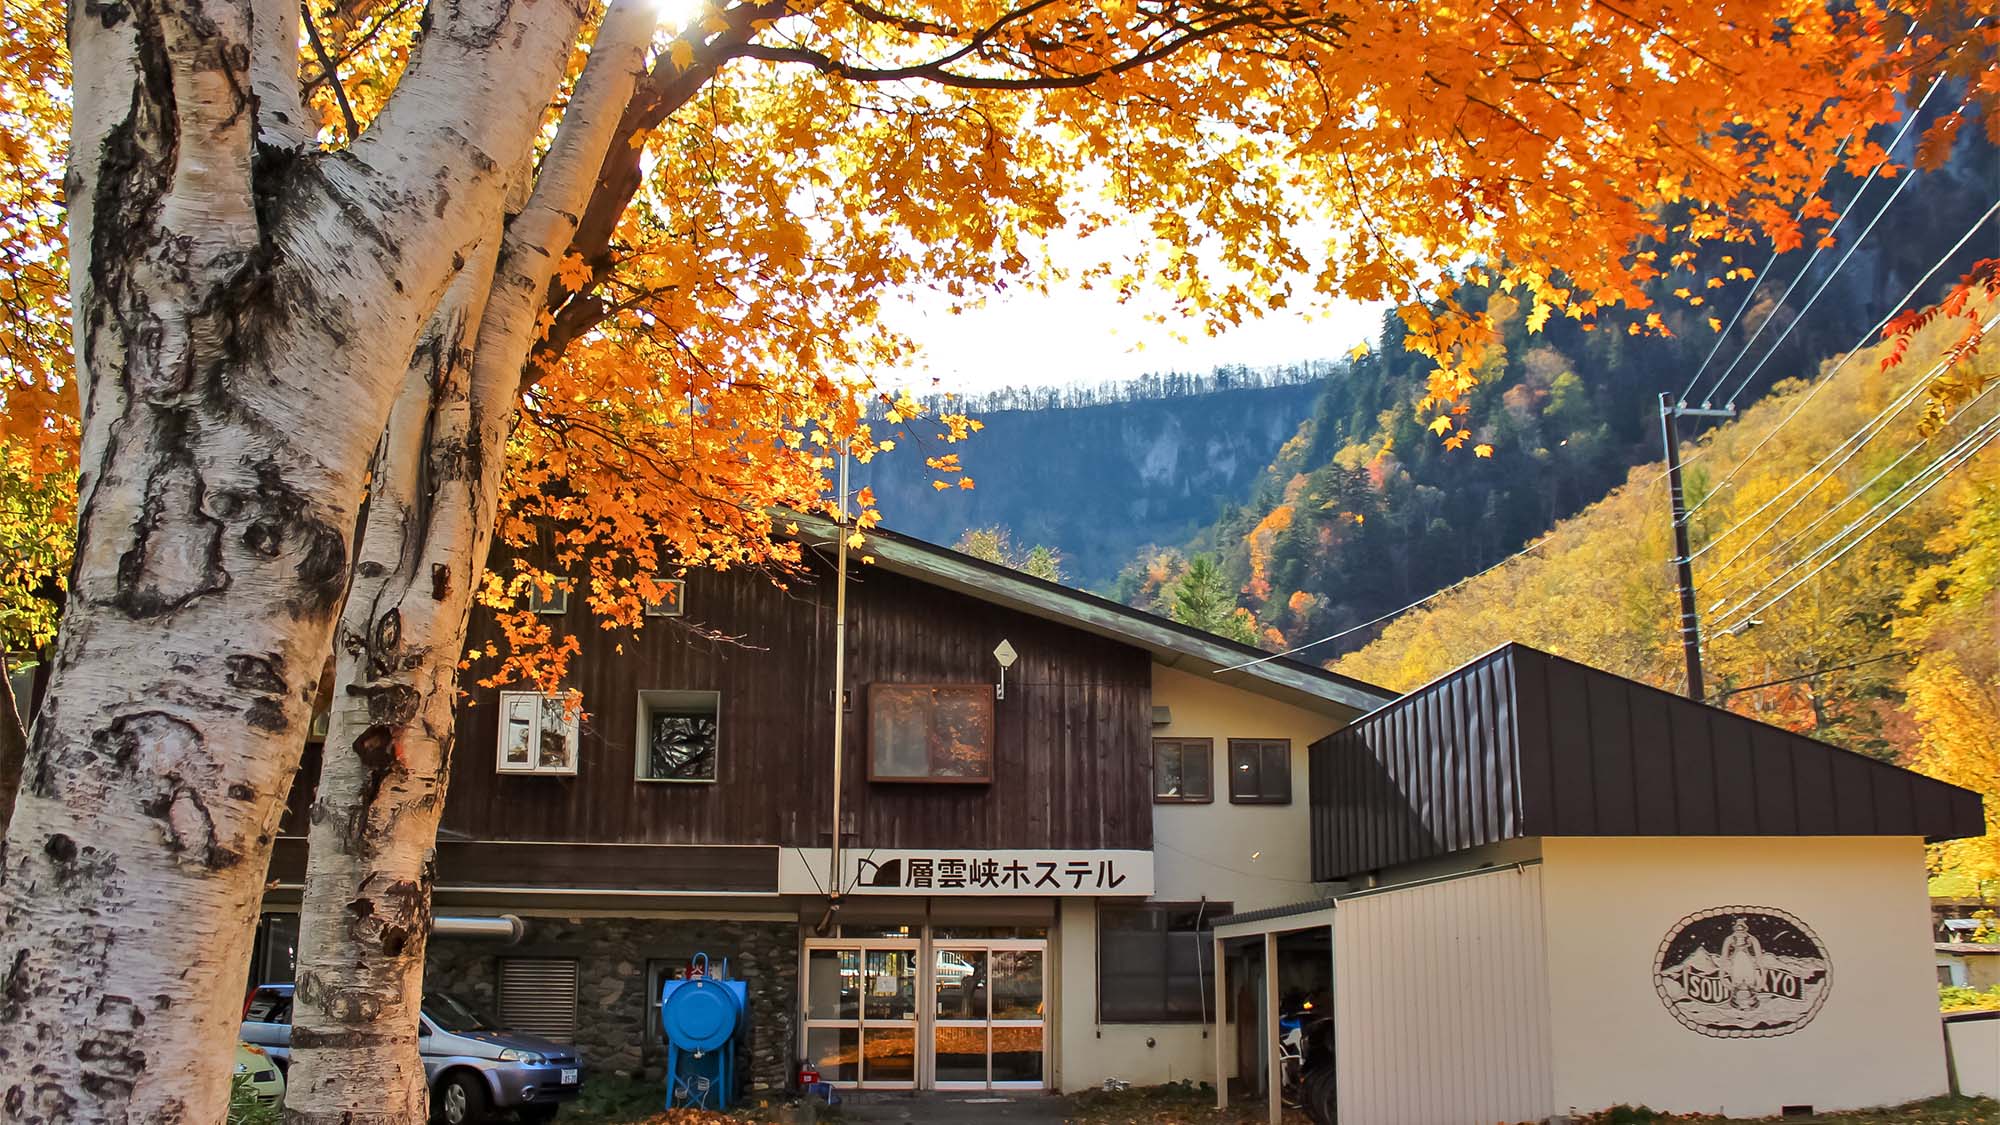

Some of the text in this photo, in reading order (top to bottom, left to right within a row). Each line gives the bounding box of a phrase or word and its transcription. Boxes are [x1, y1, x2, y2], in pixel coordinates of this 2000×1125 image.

[905, 857, 1127, 890] 層雲峡ホステル
